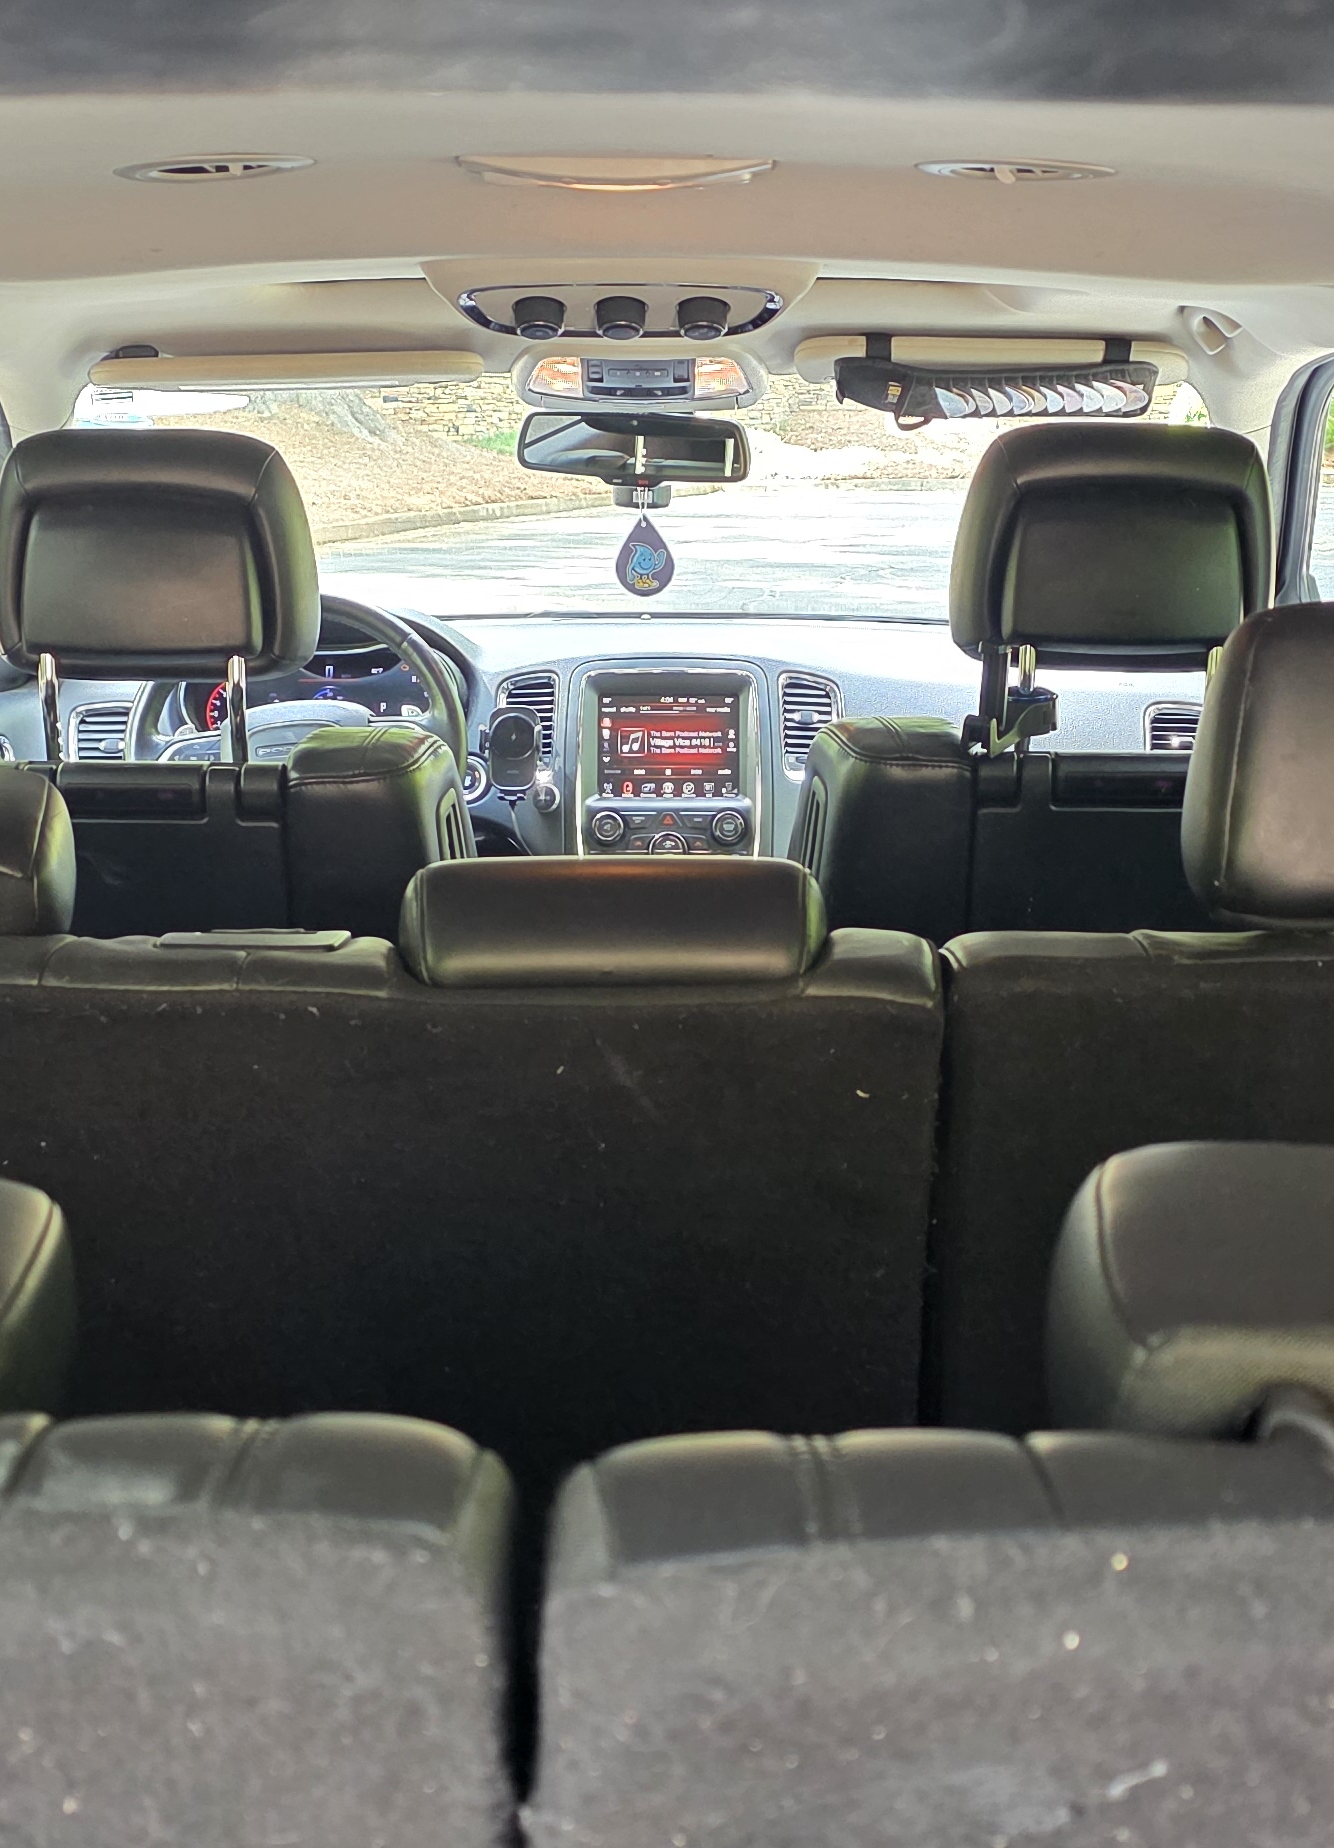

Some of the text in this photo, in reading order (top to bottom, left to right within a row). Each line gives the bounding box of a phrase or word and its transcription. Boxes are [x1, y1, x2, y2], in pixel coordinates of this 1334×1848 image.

[380, 702, 387, 713] P
[649, 737, 674, 747] Village
[674, 737, 691, 746] Vice
